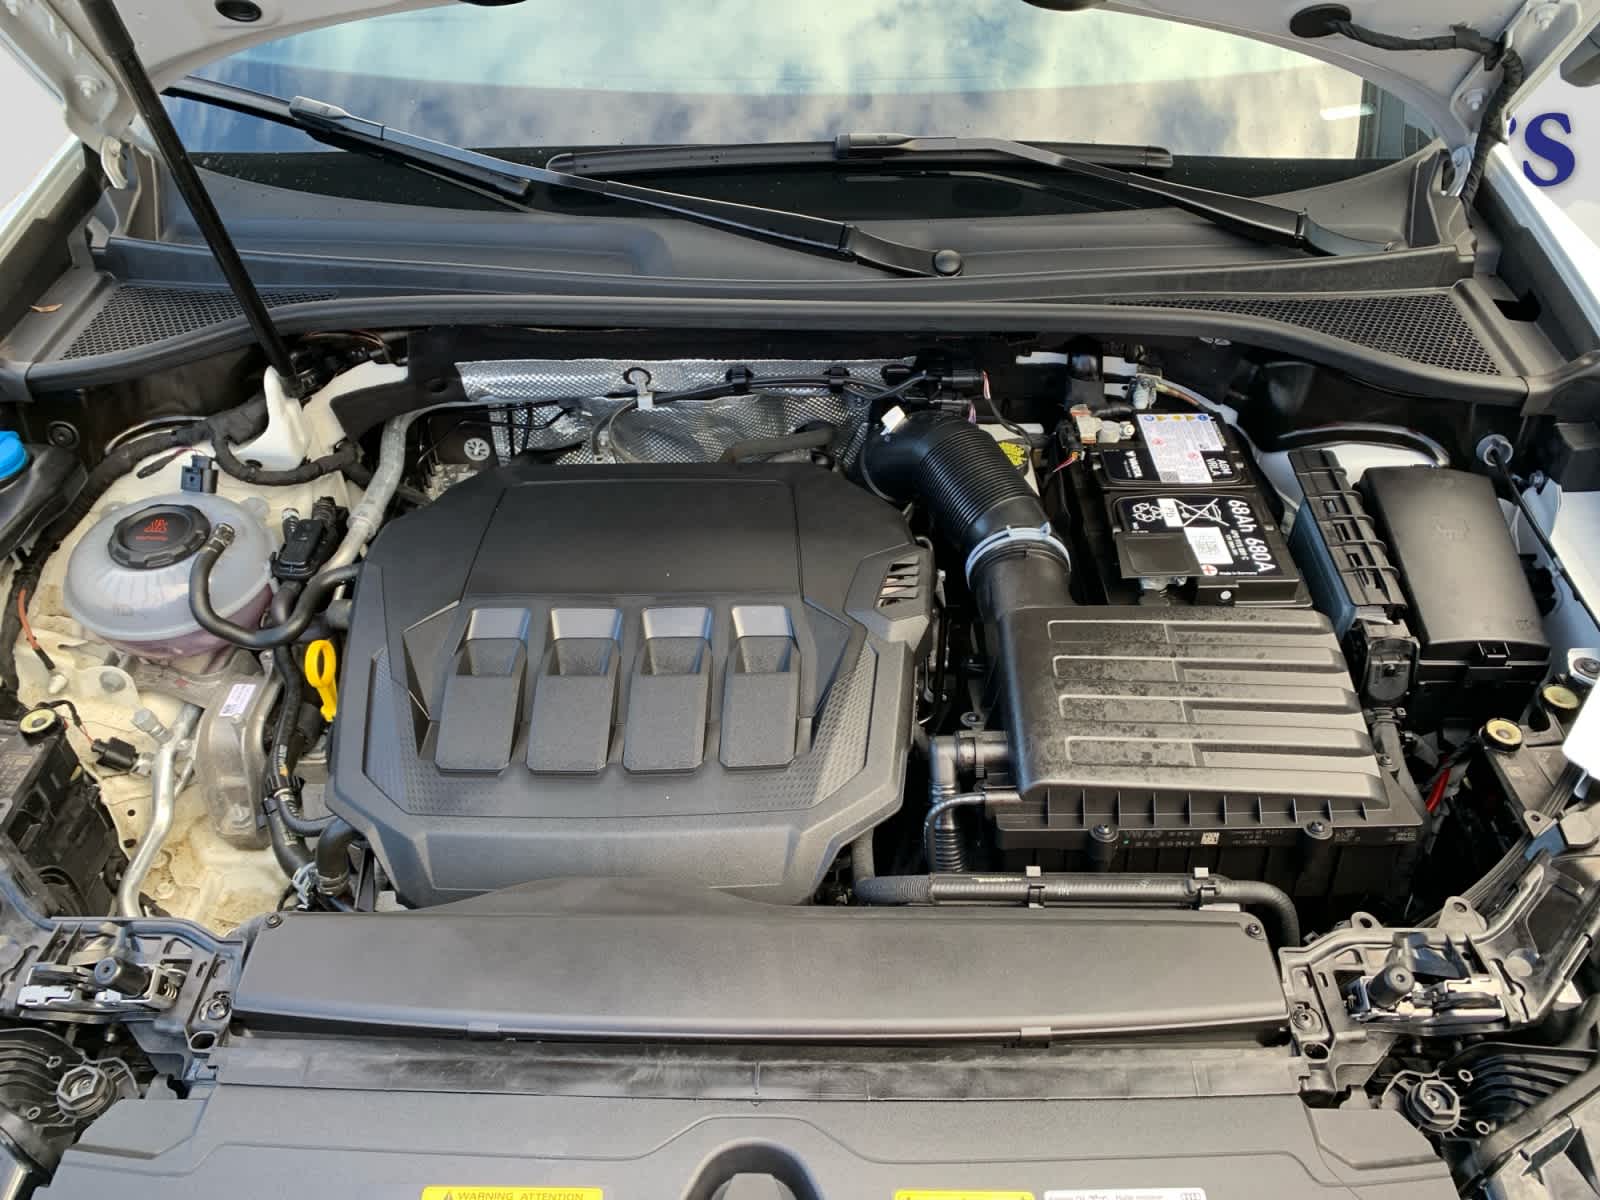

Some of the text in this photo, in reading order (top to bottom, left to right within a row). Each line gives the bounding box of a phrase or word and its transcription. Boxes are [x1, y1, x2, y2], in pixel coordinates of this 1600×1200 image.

[1509, 112, 1576, 187] S
[1227, 499, 1257, 533] 68Ah
[1244, 537, 1277, 573] 680A
[457, 1191, 513, 1200] WARNING
